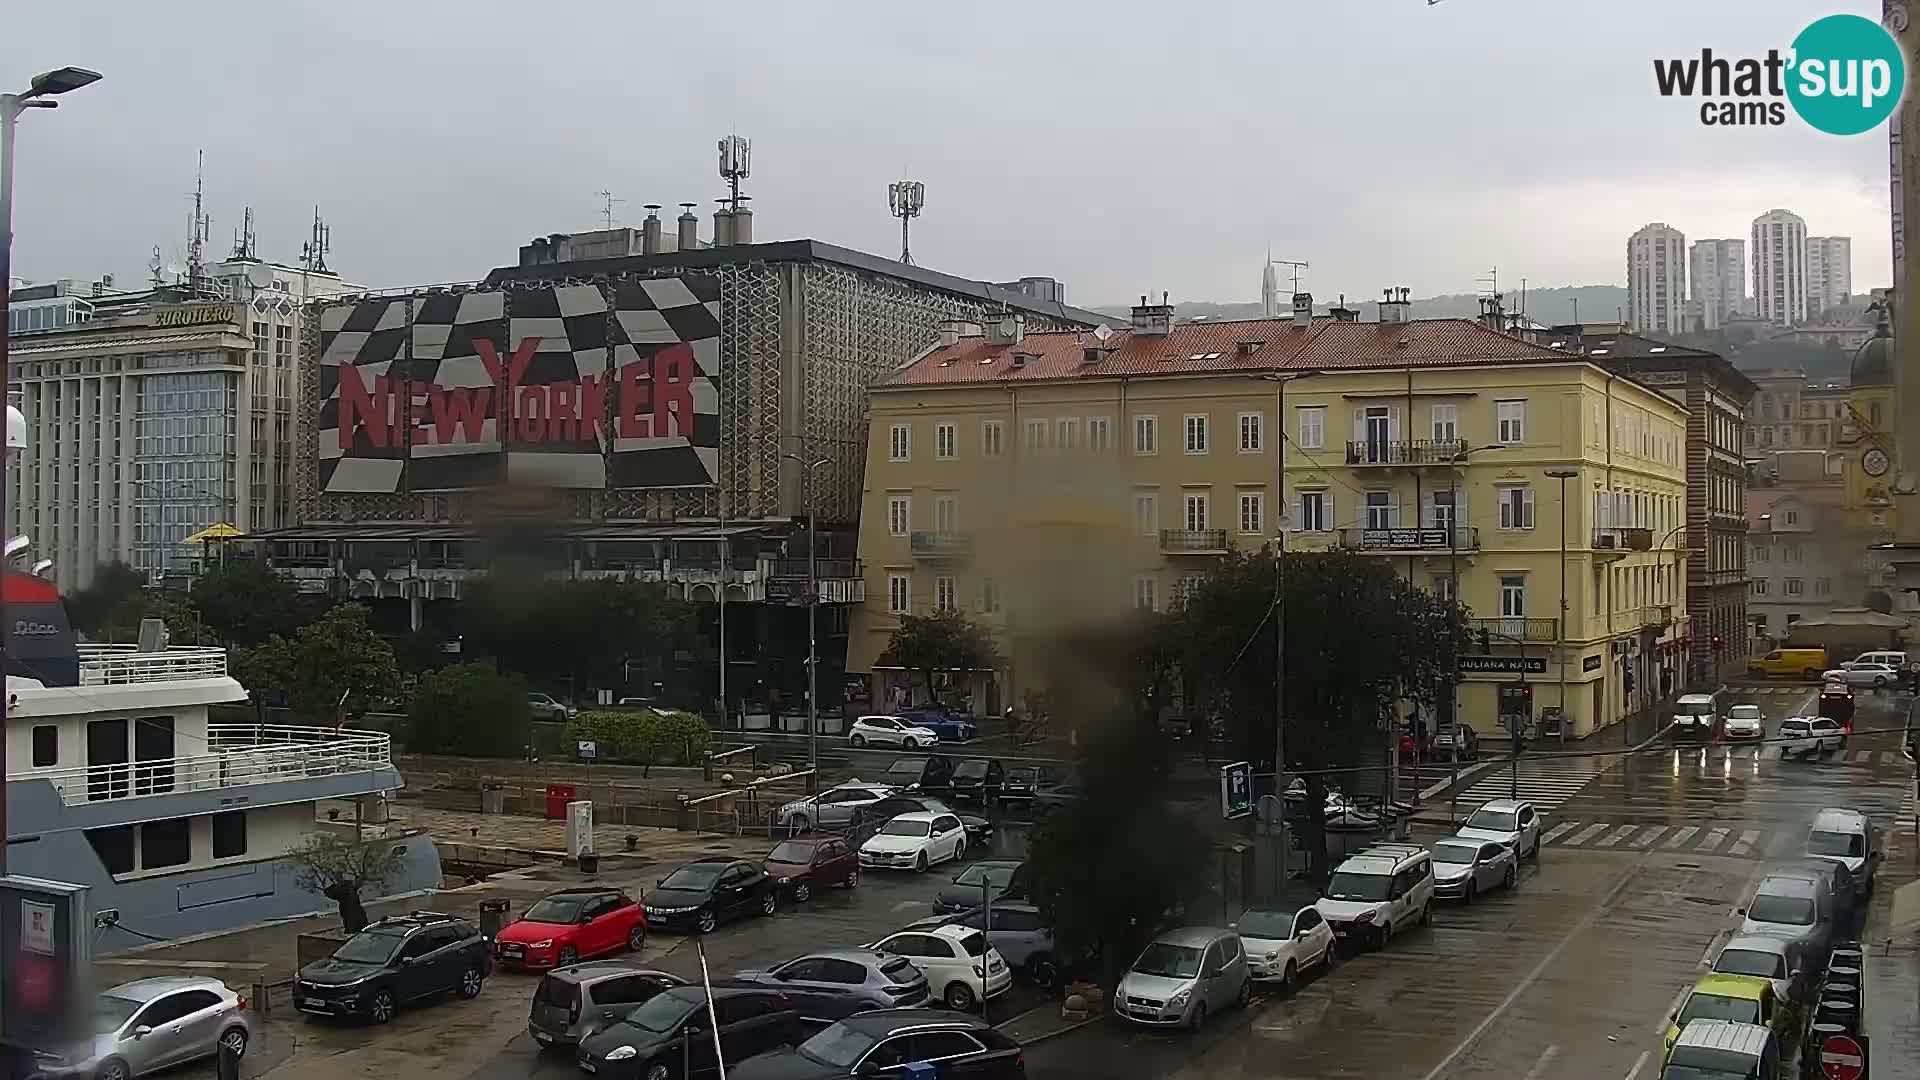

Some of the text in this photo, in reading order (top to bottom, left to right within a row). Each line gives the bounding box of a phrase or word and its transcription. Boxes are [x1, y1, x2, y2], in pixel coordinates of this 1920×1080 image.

[338, 336, 694, 449] NEW YORKER
[1460, 660, 1505, 670] JULIANA
